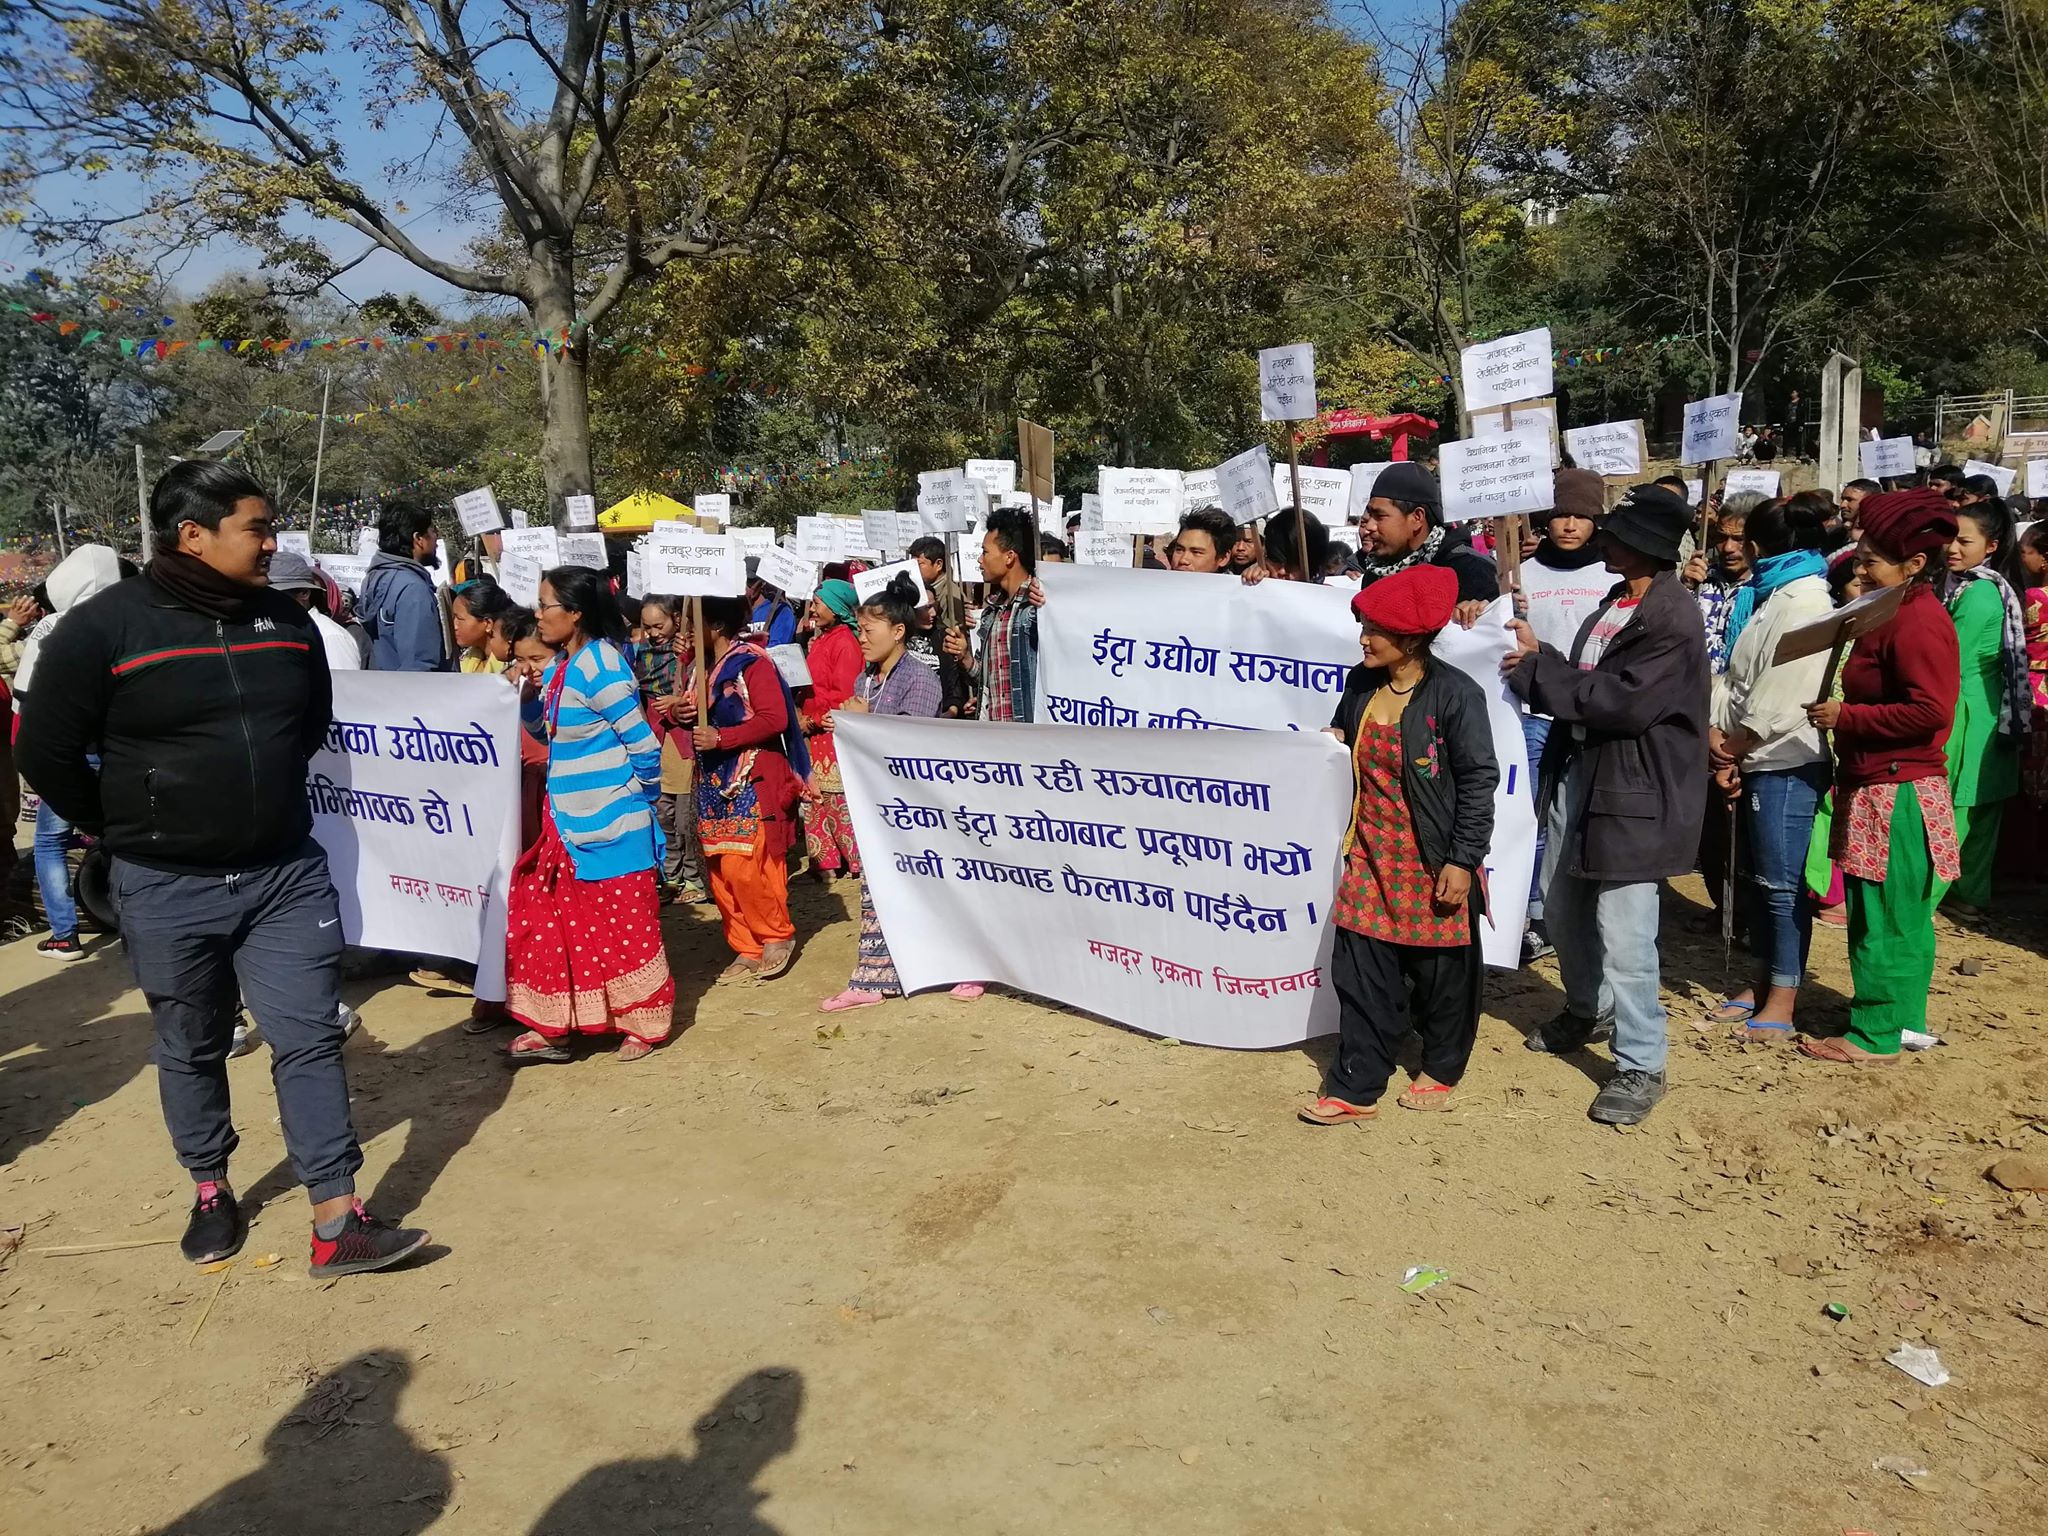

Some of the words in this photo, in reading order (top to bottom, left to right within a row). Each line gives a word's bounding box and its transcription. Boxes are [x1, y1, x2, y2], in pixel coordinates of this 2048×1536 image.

[1283, 475, 1312, 491] मदूर
[659, 545, 692, 559] मजदूर
[694, 547, 726, 559] एकता
[1531, 590, 1552, 600] STOP
[1566, 587, 1605, 597] NOTHING
[253, 616, 276, 633] H&M
[1144, 635, 1221, 676] उद्योग
[1229, 651, 1353, 692] सञ्चाल
[385, 717, 499, 768] उद्योगको
[884, 756, 1024, 787] मापदण्डमा
[1031, 758, 1084, 793] रही
[1091, 768, 1271, 812] सञ्चालनमा
[419, 788, 453, 835] हो
[876, 797, 948, 831] रहेका
[1004, 809, 1127, 850] उद्योगबाट
[1135, 827, 1233, 868] प्रदूषण
[1243, 842, 1313, 876] भयो
[389, 875, 432, 904] मजदूर
[435, 882, 474, 908] एकता
[893, 849, 944, 880] भनी
[952, 857, 1055, 893] अफवाह
[1061, 863, 1175, 913] फैलाउन
[1184, 891, 1288, 934] पाईदैन
[1087, 939, 1143, 975] मजदूर
[1151, 955, 1203, 989] एकता
[1213, 966, 1322, 999] जिन्दावाद
